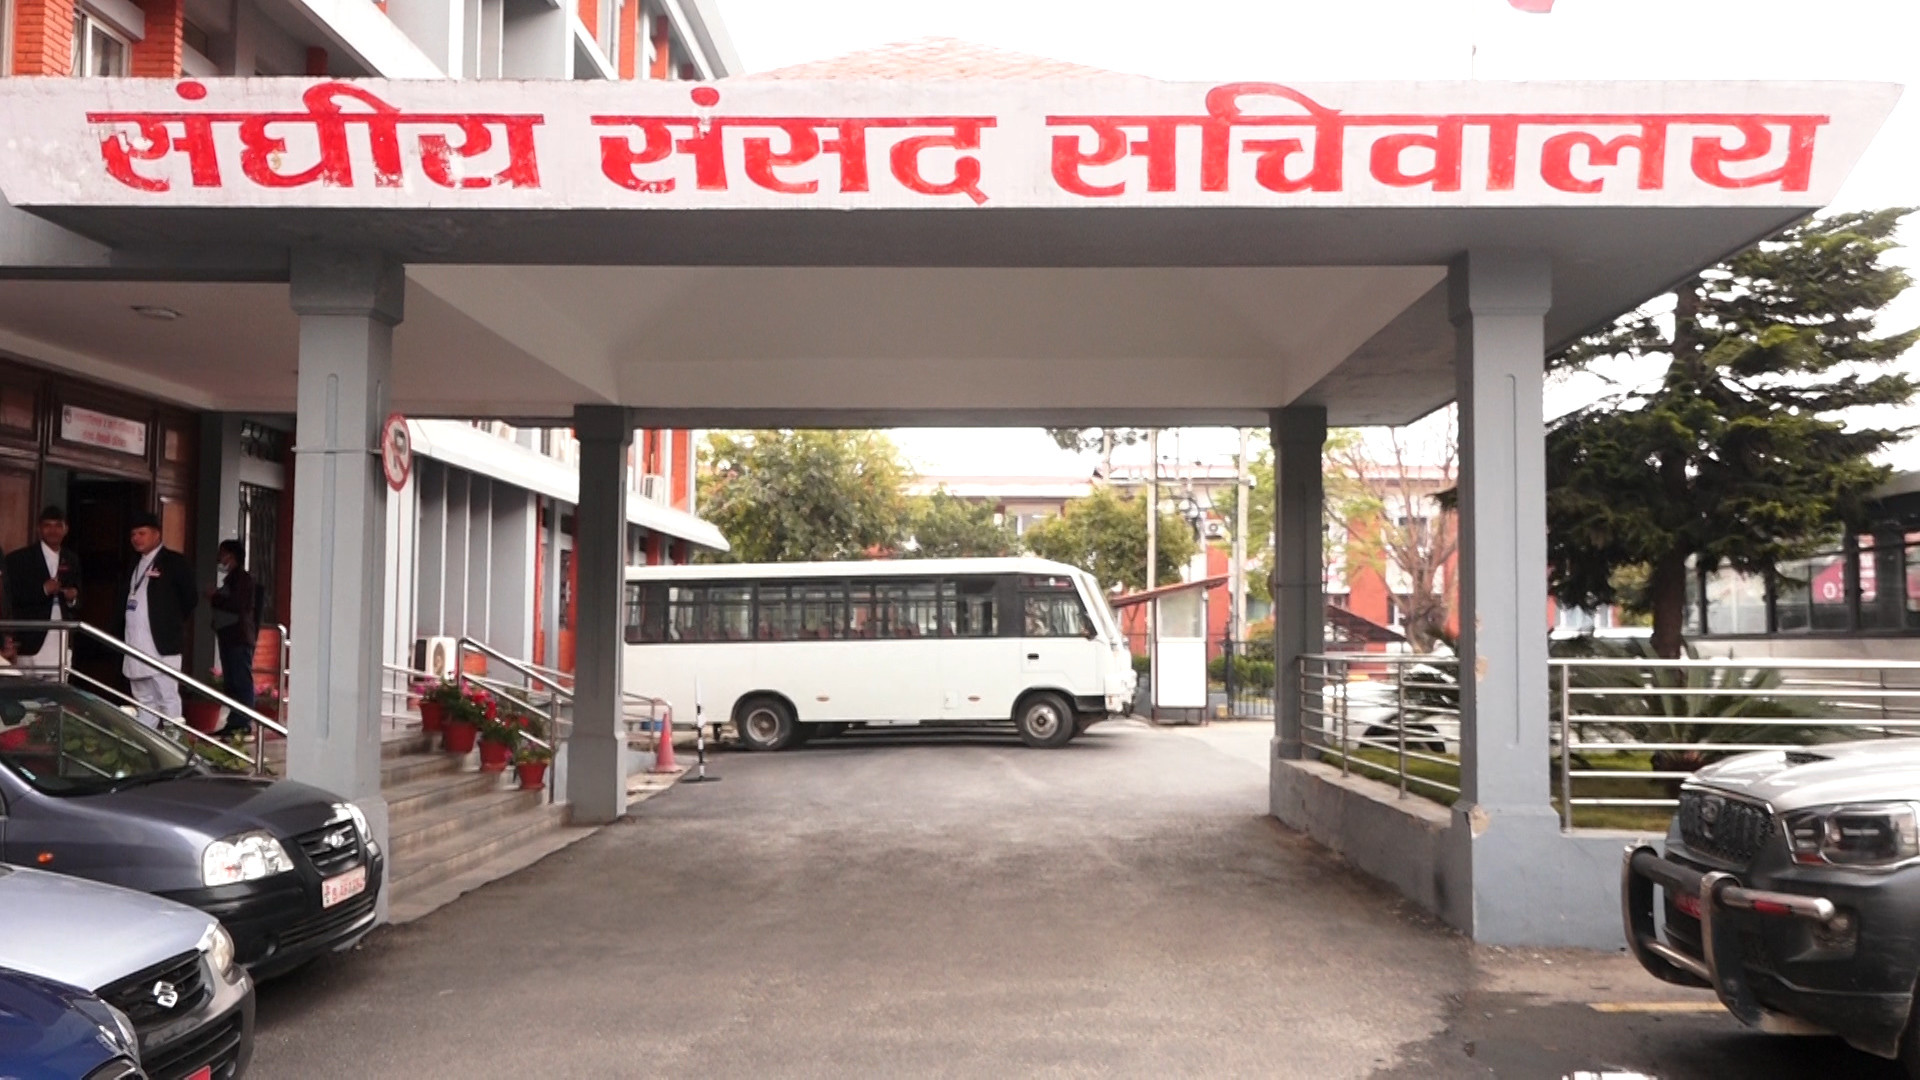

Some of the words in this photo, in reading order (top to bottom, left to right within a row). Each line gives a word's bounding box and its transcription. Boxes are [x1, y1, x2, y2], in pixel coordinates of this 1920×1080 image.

[86, 81, 545, 193] संघीय
[591, 86, 997, 204] संसद
[1045, 82, 1830, 197] सचिवालय
